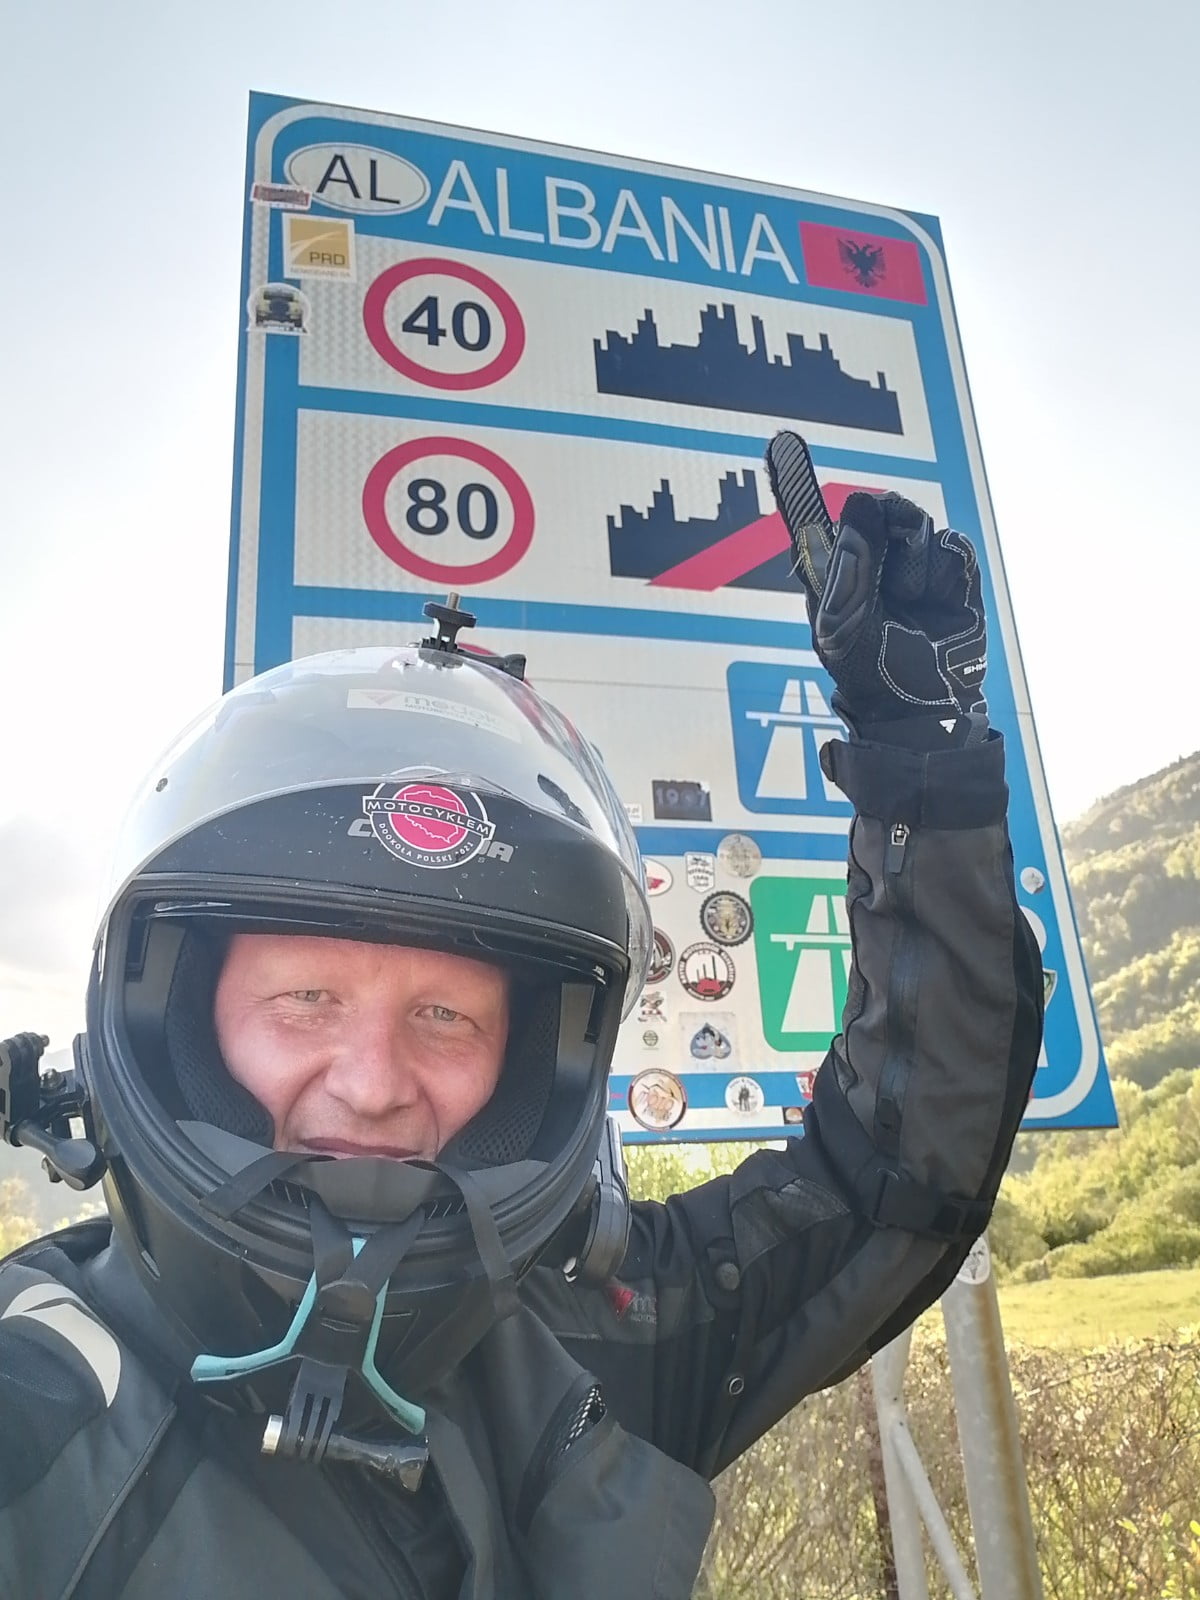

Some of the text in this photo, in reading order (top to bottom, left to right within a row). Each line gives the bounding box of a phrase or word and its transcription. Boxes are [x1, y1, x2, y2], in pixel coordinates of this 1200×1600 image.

[316, 154, 401, 205] AL
[427, 159, 800, 285] ALBANIA
[309, 251, 345, 265] PRD
[402, 295, 491, 352] 40
[405, 478, 499, 540] 80
[367, 800, 490, 836] MOTOCYKLEM
[379, 823, 412, 857] DOOKOŁA
[416, 853, 453, 863] POLSKI
[455, 841, 474, 857] 021
